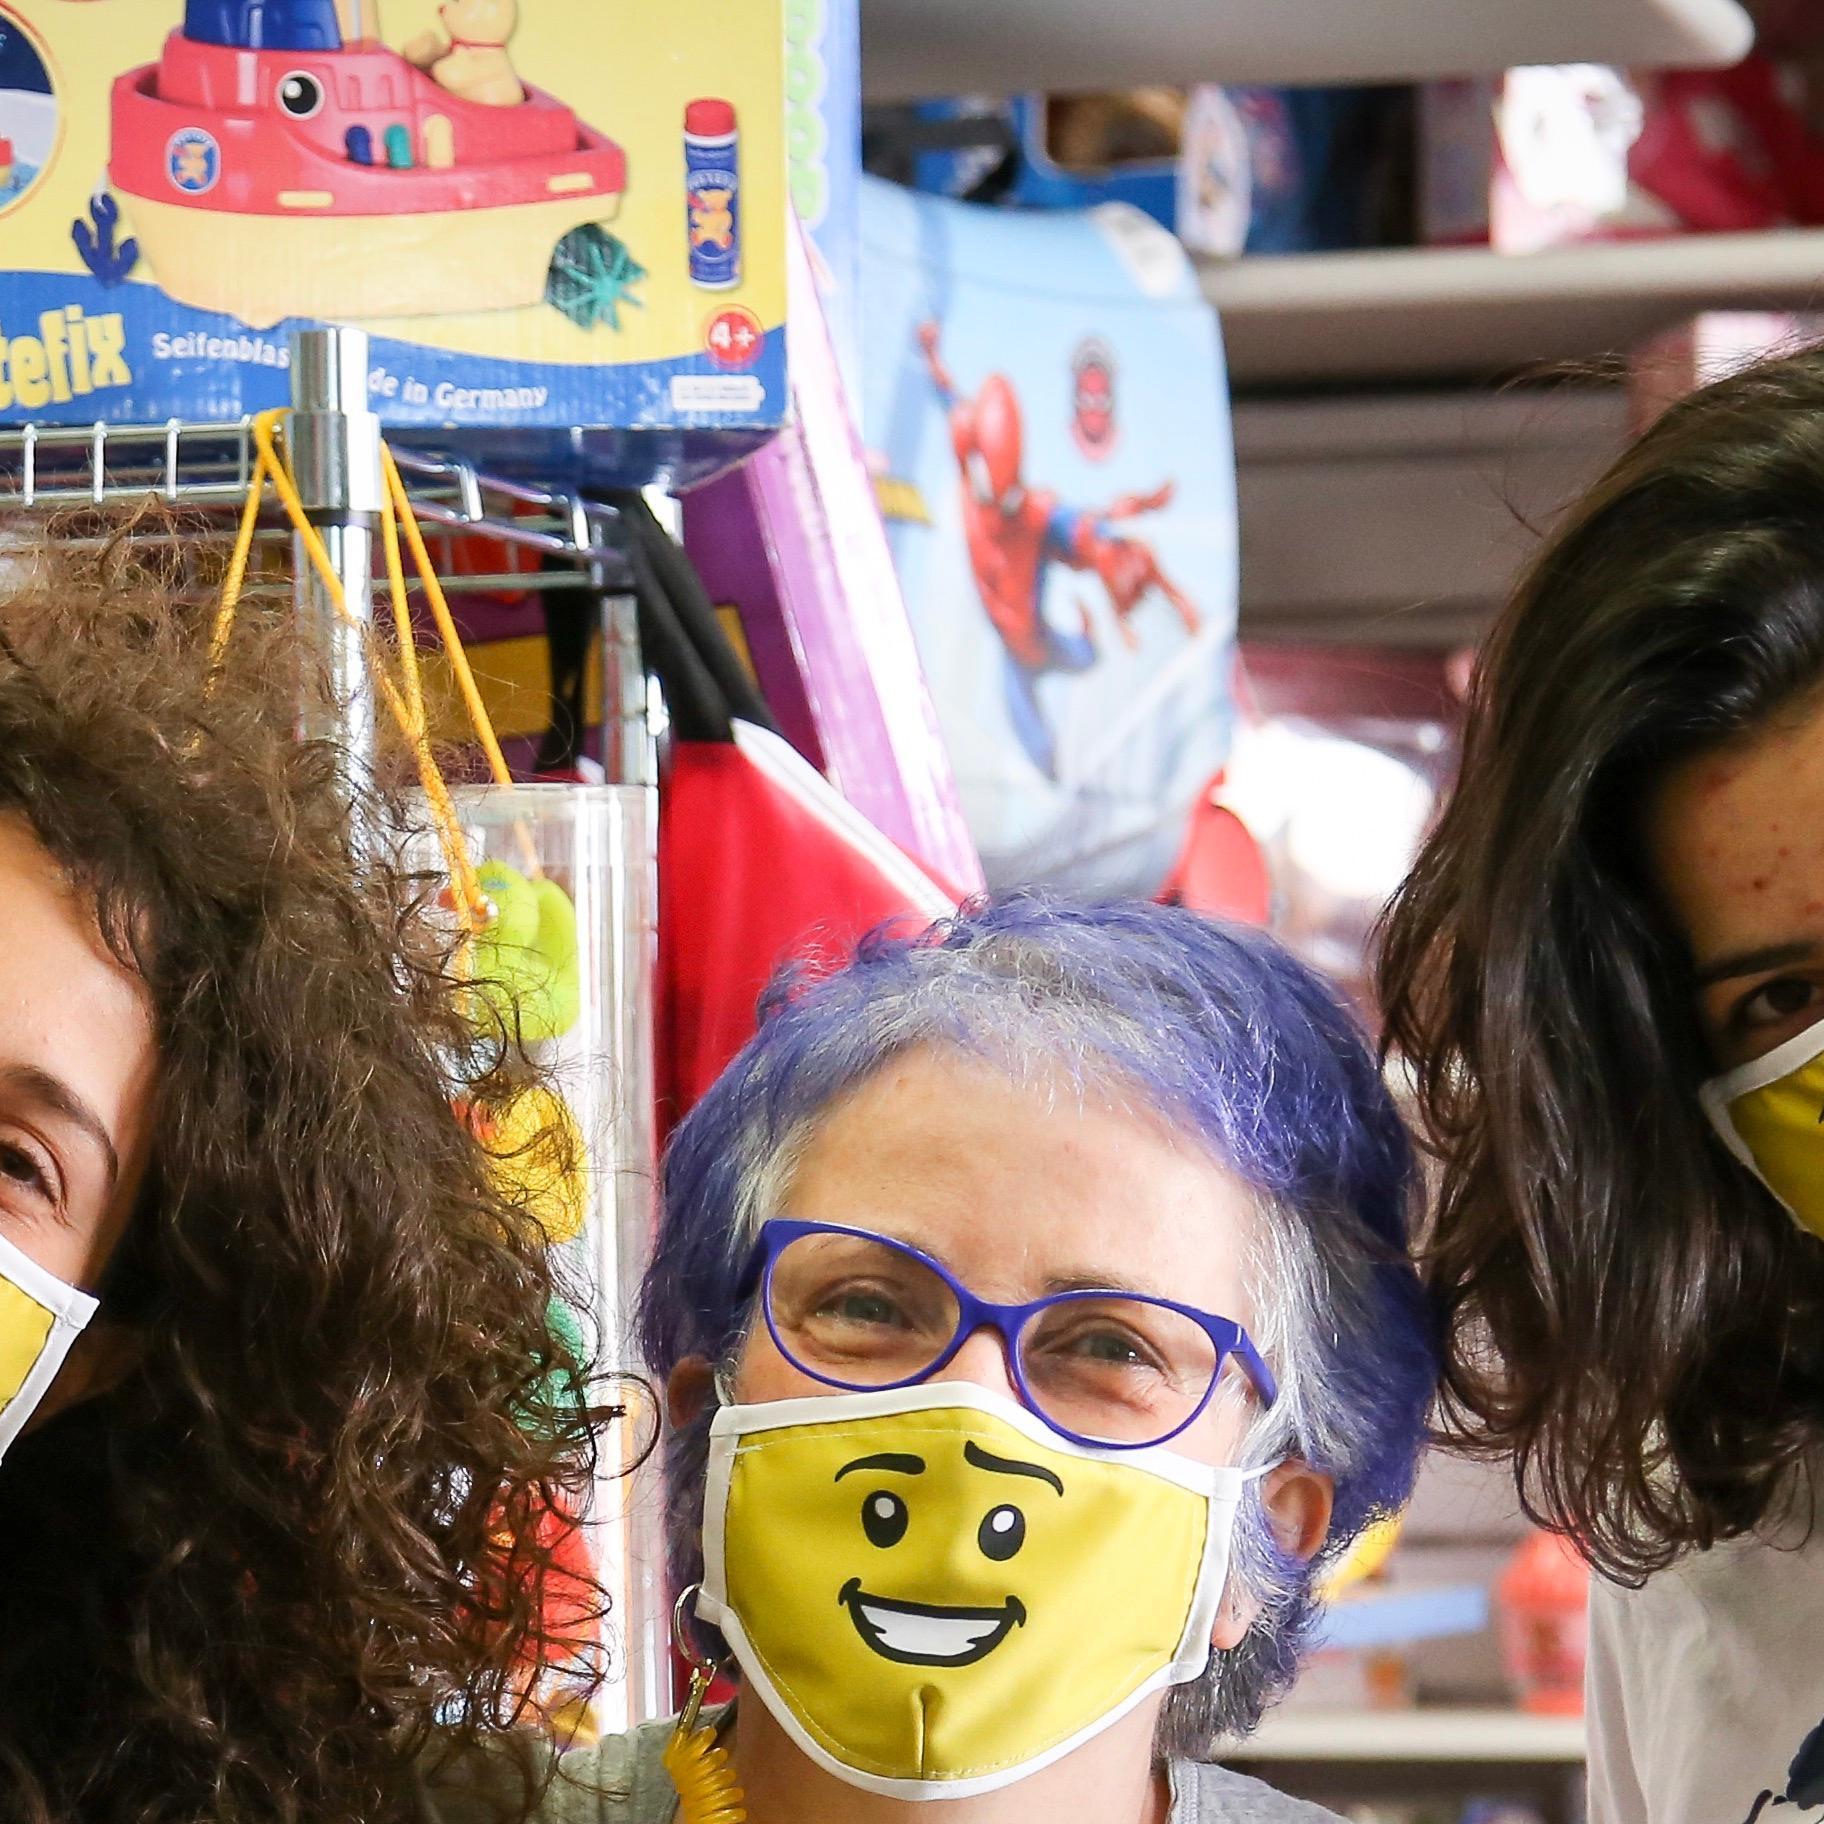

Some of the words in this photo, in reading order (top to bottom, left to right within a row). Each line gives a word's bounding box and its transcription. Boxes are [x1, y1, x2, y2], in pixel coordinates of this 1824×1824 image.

[709, 320, 756, 349] 4+
[152, 332, 290, 368] Seifenblas
[404, 377, 429, 402] in
[434, 381, 548, 408] Germany
